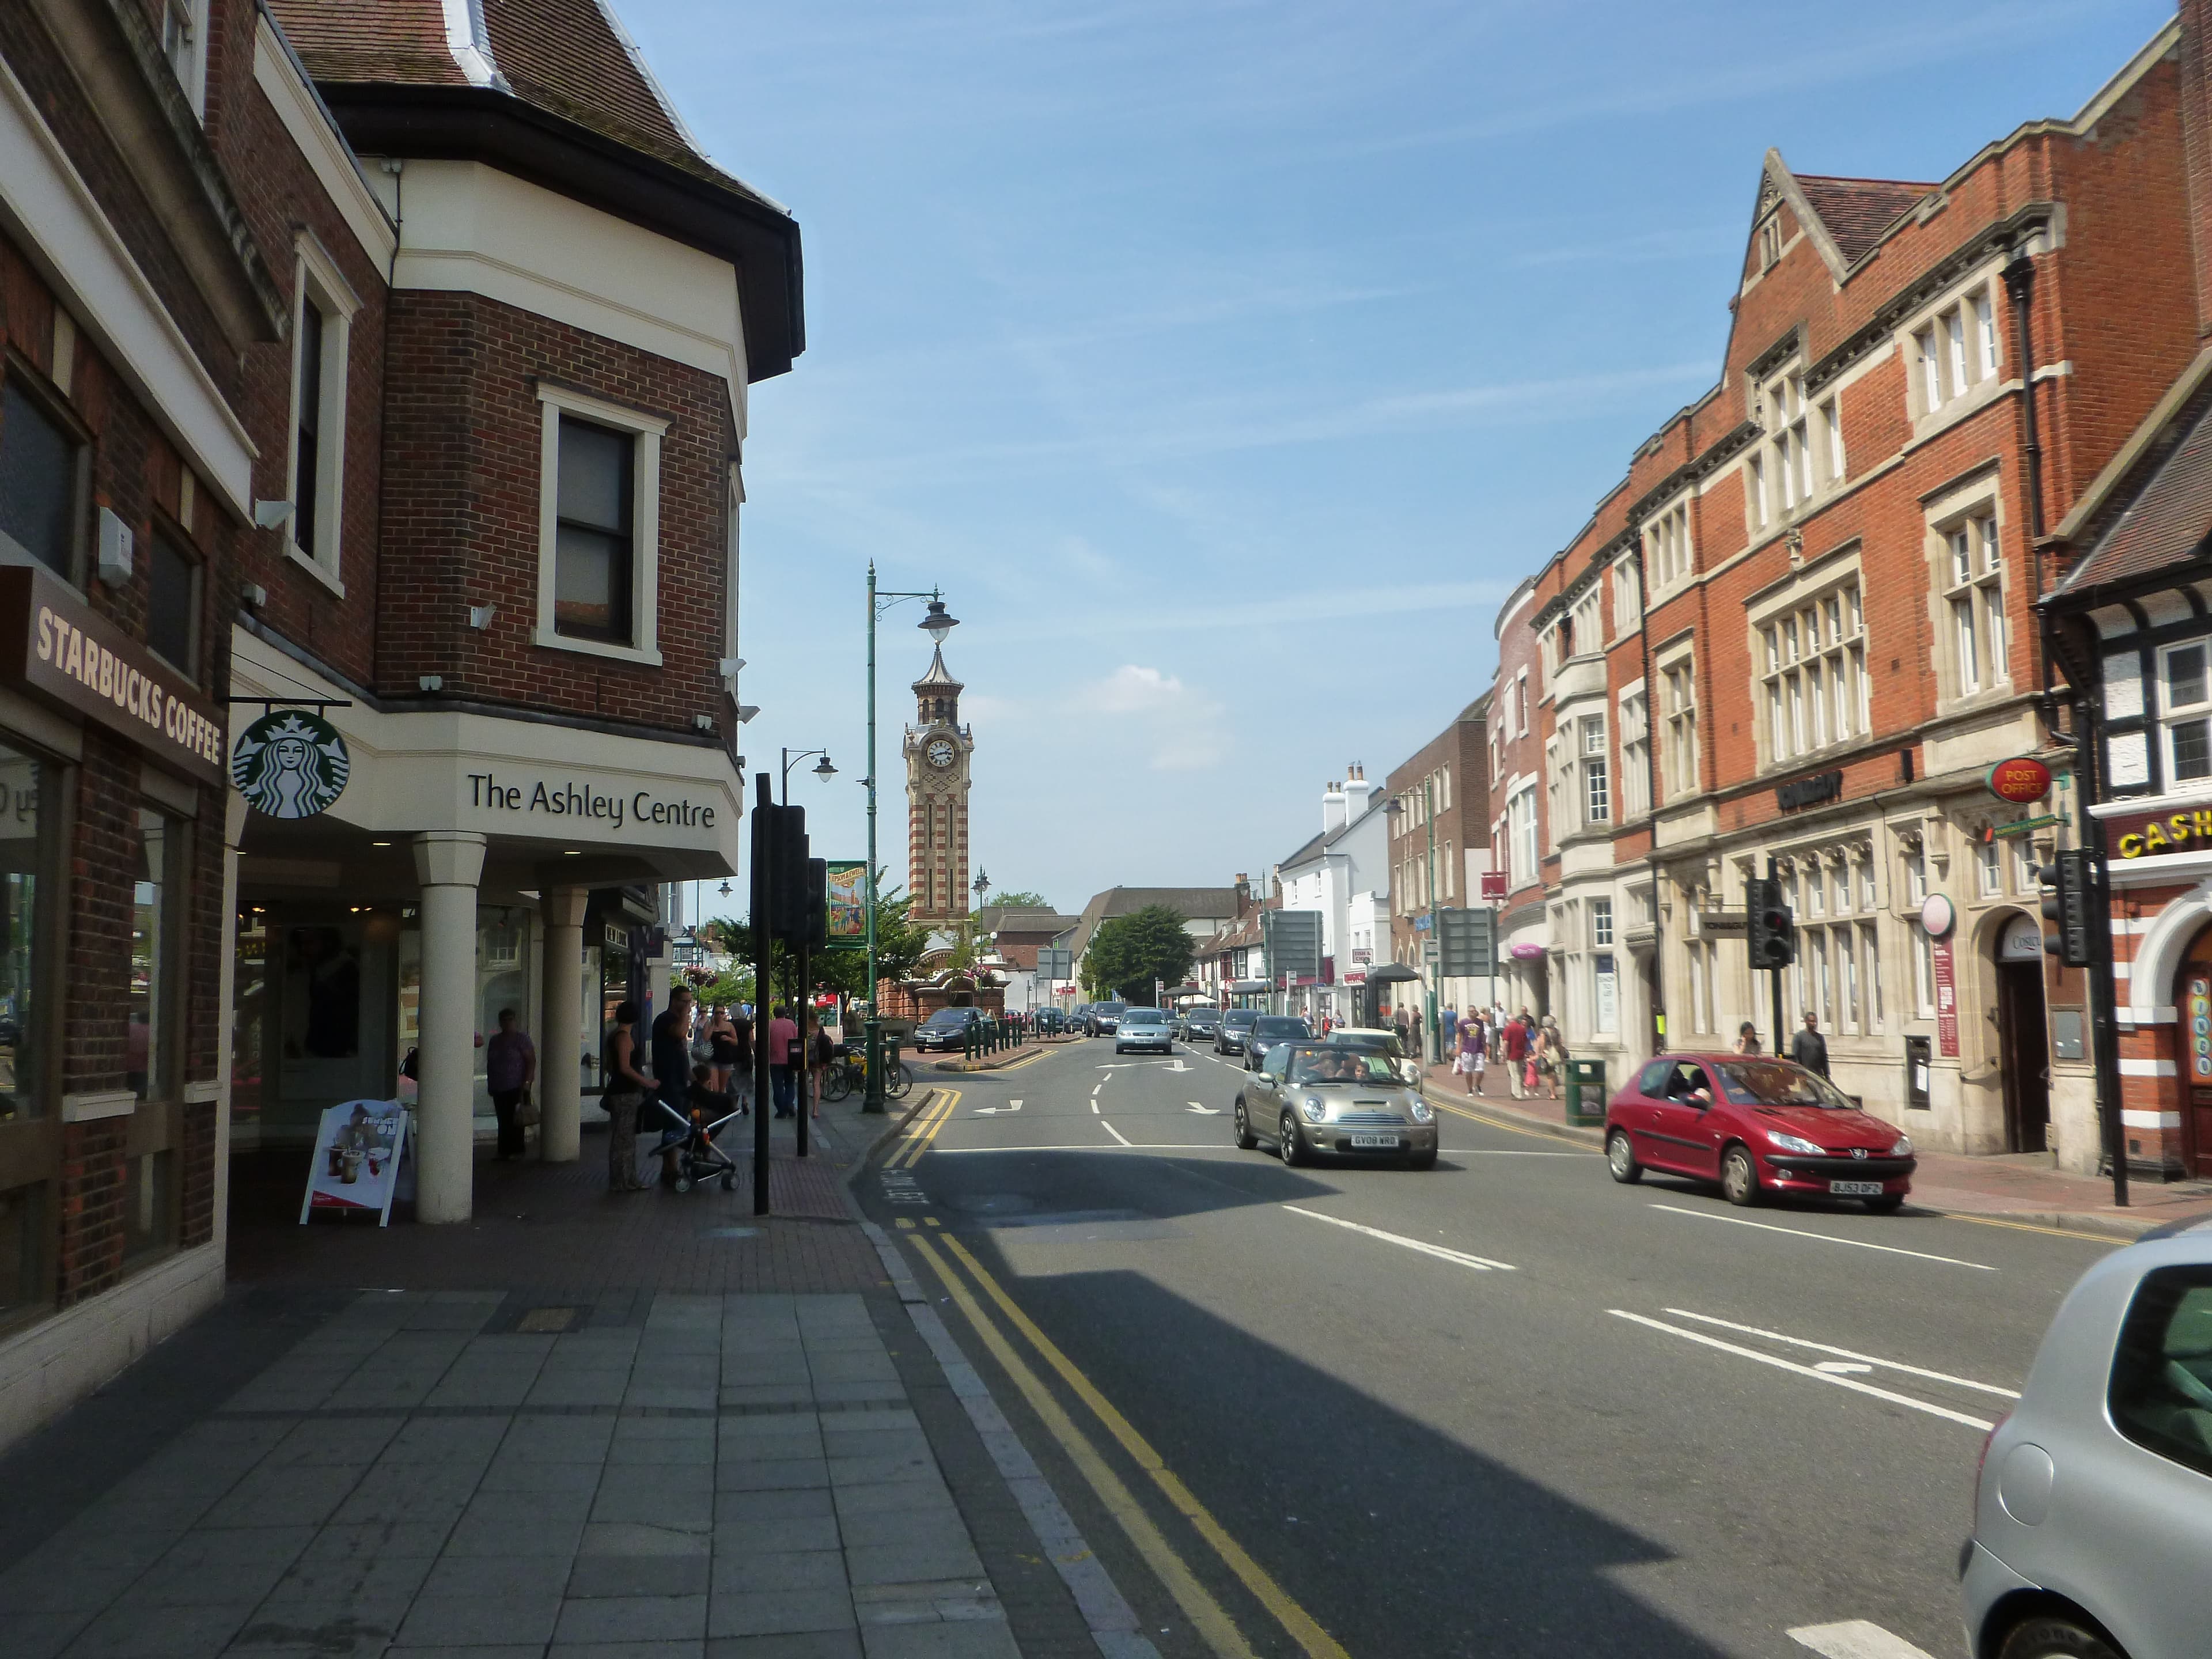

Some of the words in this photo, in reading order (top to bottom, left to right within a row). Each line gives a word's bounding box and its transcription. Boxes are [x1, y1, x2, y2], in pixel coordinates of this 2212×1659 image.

[37, 606, 162, 729] STARBUCKS
[165, 695, 220, 765] COFFEE
[2001, 782, 2043, 794] OFFICE
[2005, 770, 2037, 781] POST
[468, 774, 522, 810] The
[529, 781, 624, 829] Ashley
[633, 791, 715, 828] Centre
[2119, 810, 2212, 859] CASH
